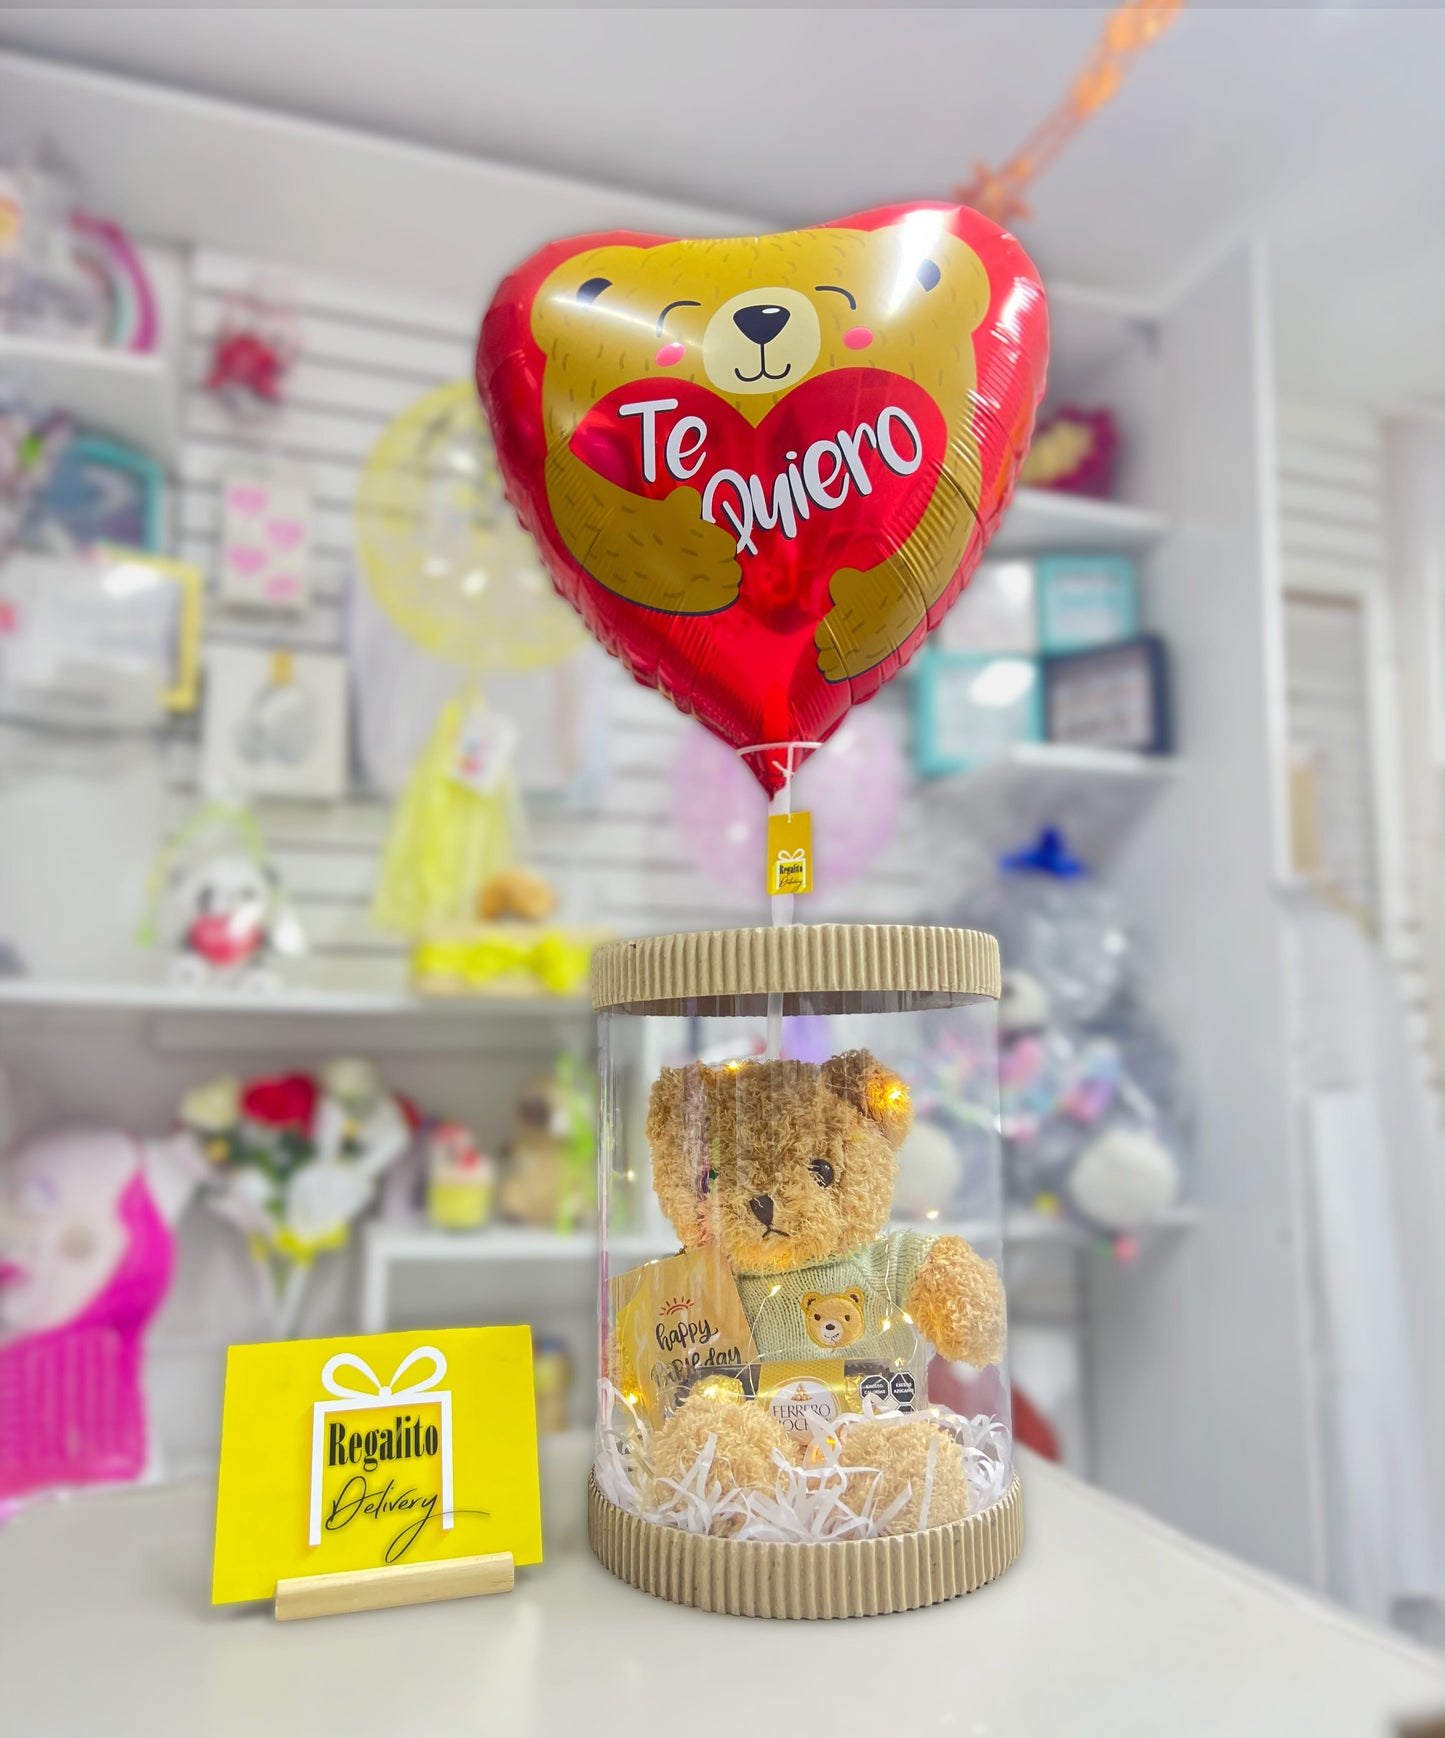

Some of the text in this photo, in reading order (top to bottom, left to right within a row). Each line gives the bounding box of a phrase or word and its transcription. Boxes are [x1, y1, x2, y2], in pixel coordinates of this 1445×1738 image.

[618, 398, 707, 484] Te
[701, 406, 923, 557] Quiero
[779, 864, 803, 875] Regalito
[655, 1319, 718, 1351] happy
[327, 1415, 439, 1472] Regalito
[325, 1475, 490, 1563] Delivery
